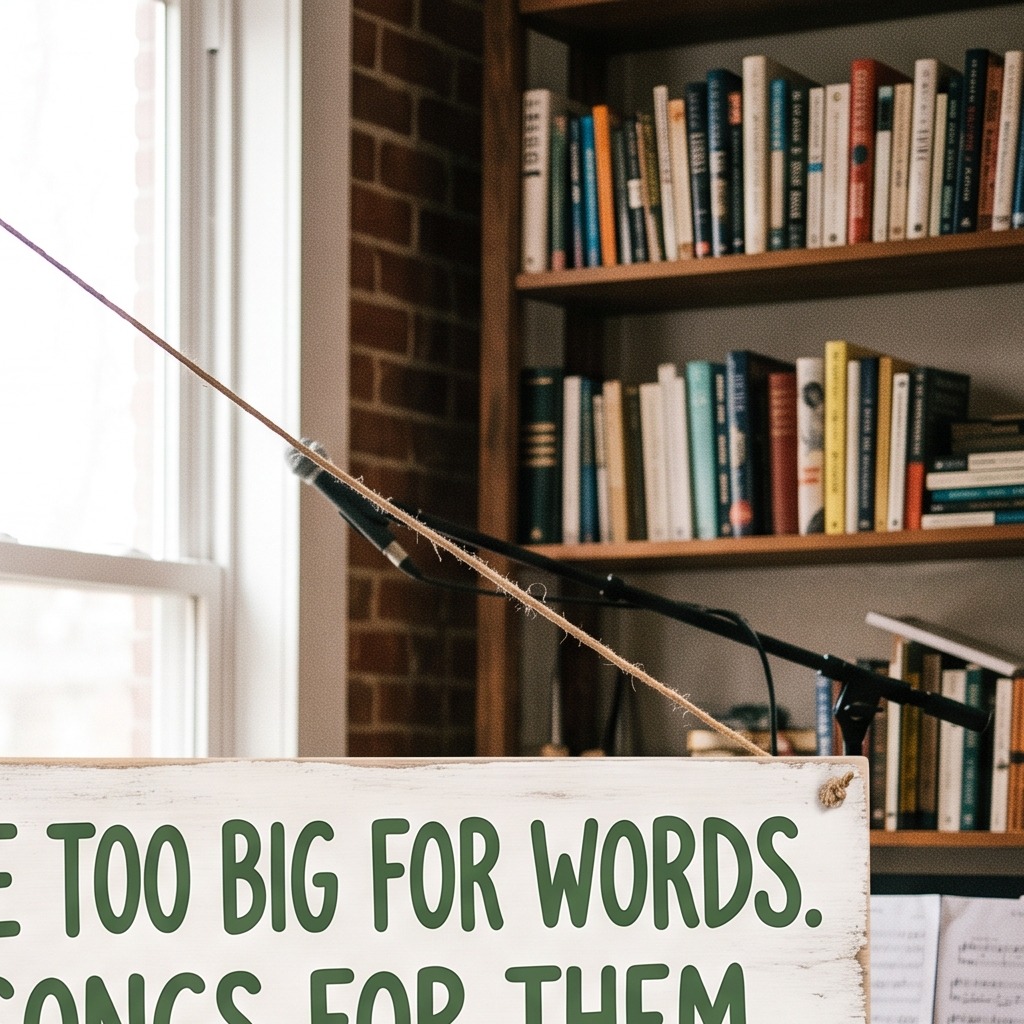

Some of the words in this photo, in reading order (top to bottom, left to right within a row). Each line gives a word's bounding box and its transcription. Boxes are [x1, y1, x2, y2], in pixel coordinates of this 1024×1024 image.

[47, 822, 189, 937] TOO
[222, 820, 337, 933] BIG
[371, 819, 502, 931] FOR
[531, 816, 823, 929] WORDS.
